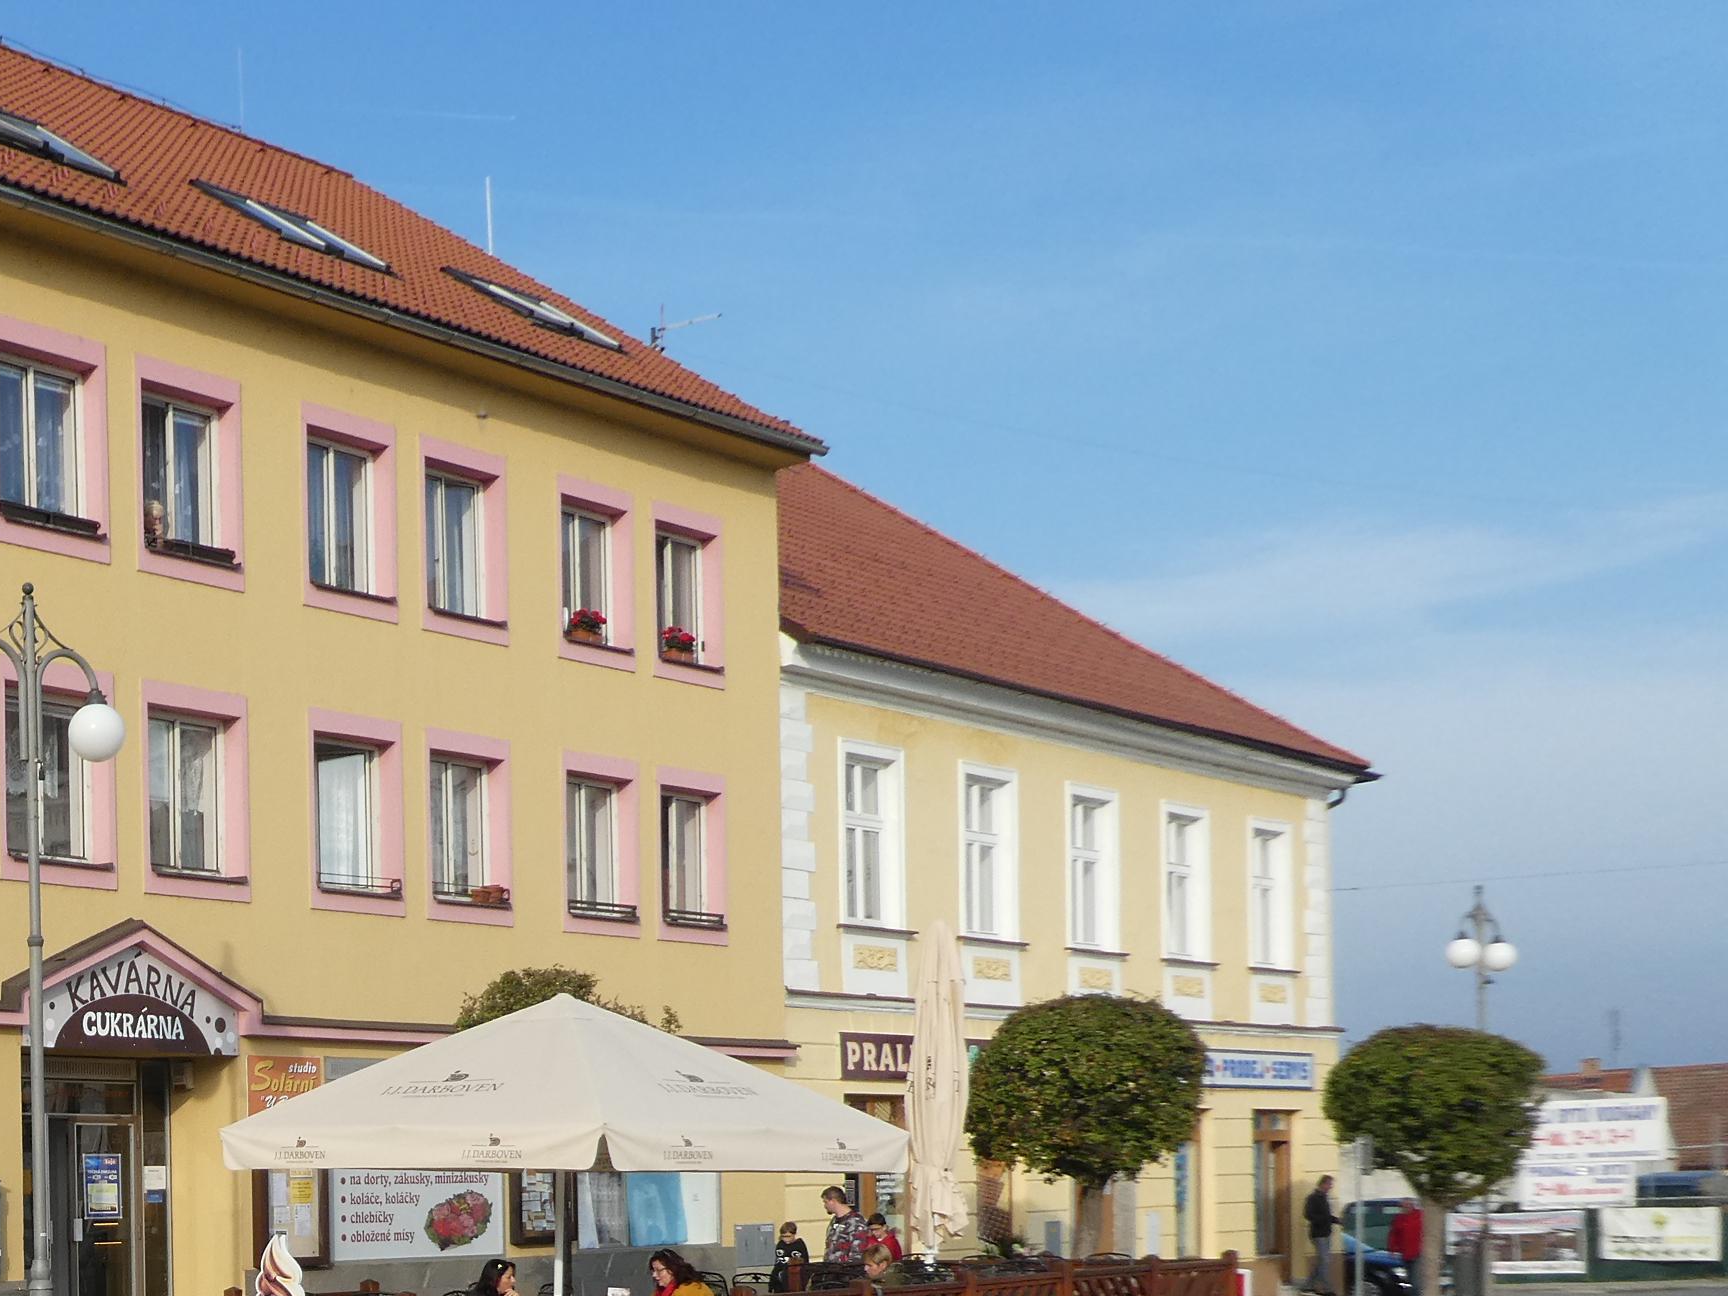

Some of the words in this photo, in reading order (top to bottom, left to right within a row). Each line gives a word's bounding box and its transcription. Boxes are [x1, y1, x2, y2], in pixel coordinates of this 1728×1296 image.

[65, 950, 197, 1020] KAVÁRNA
[82, 1006, 185, 1041] CUKRÁRNA
[845, 1040, 914, 1073] PRAL
[288, 1060, 317, 1074] studio
[250, 1060, 318, 1093] Solární
[350, 1176, 362, 1186] na
[364, 1173, 392, 1188] dorty,
[394, 1172, 433, 1187] zákusky,
[435, 1171, 490, 1186] minizákusky
[350, 1192, 383, 1207] koláče,
[385, 1191, 421, 1207] koláčky
[350, 1211, 394, 1226] chlebíčky
[350, 1230, 391, 1244] obložené
[393, 1229, 415, 1244] mísy
